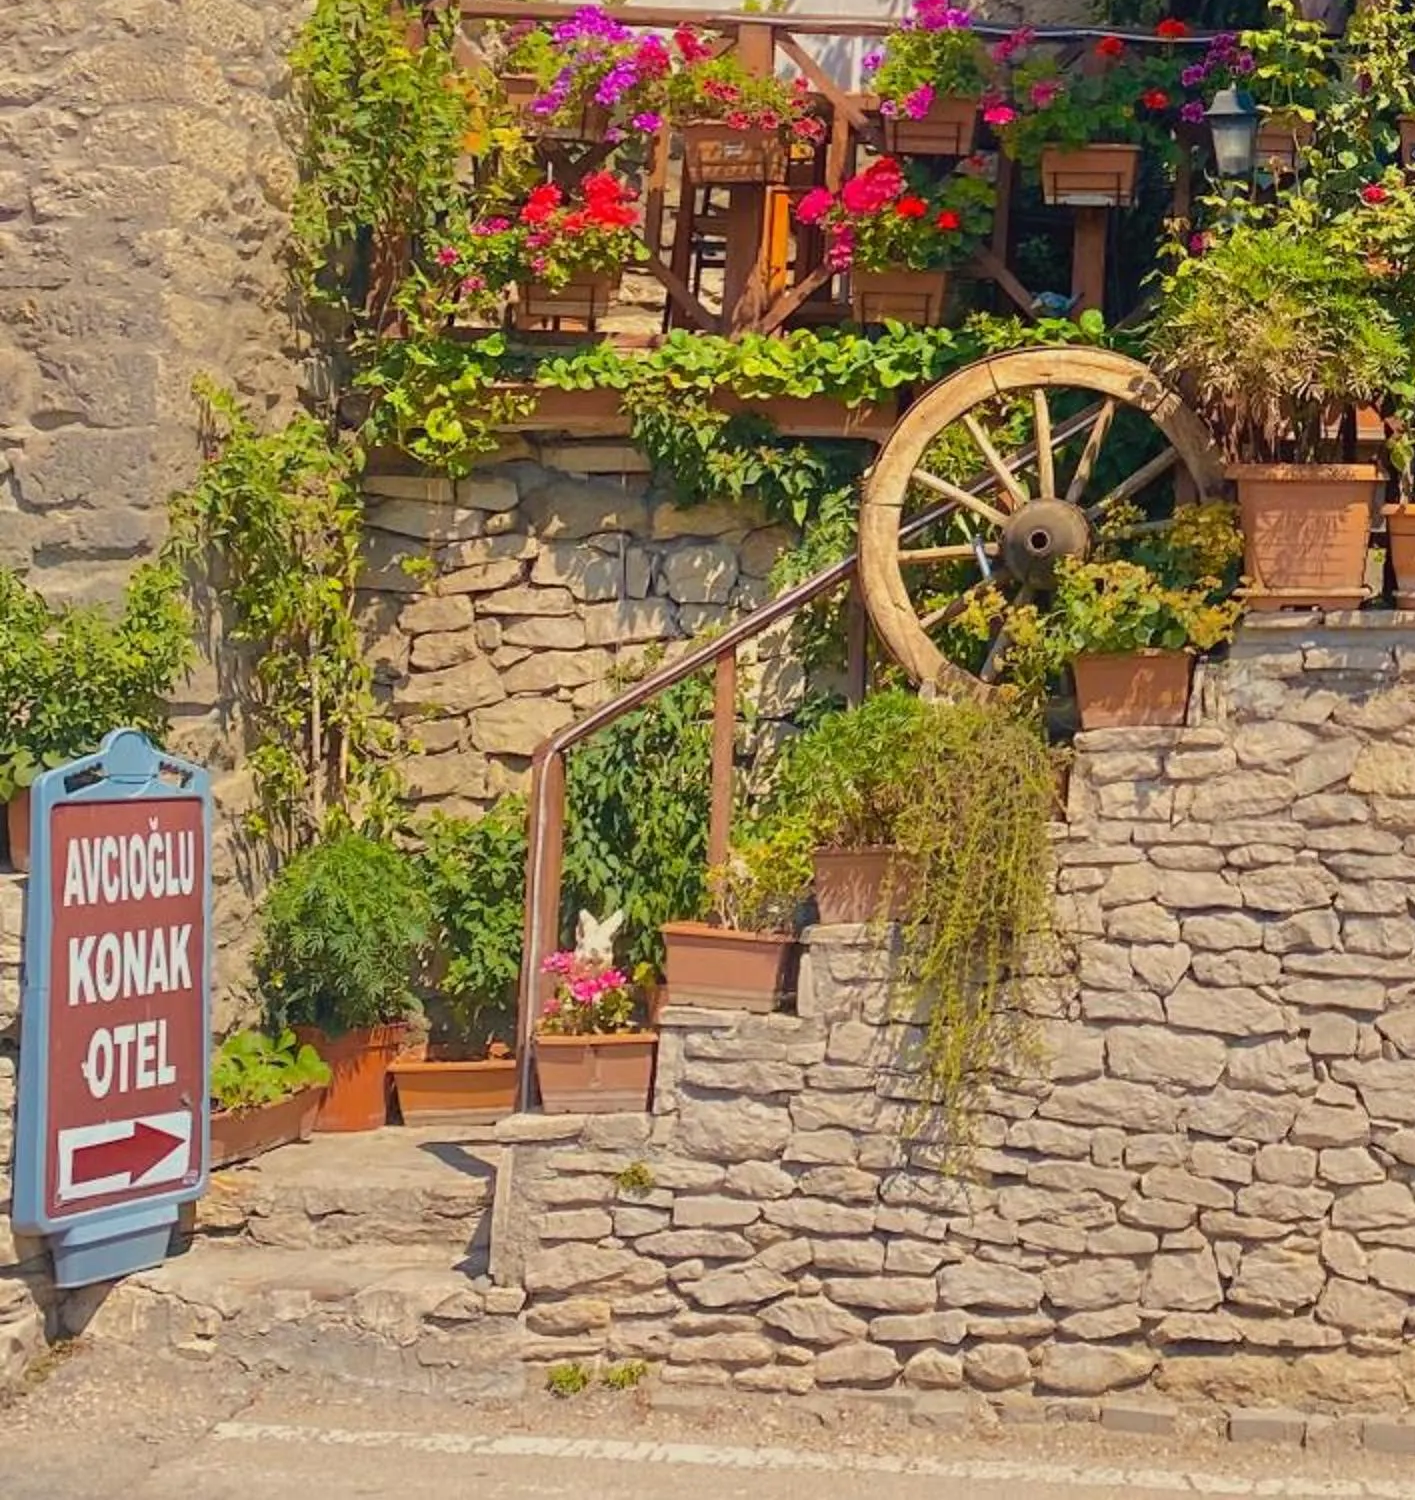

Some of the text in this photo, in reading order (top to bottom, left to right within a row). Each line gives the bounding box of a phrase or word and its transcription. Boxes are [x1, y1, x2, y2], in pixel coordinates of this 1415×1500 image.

[63, 816, 195, 907] AVCIOĞLU
[68, 924, 192, 1006] KONAK
[84, 1019, 176, 1099] OTEL
